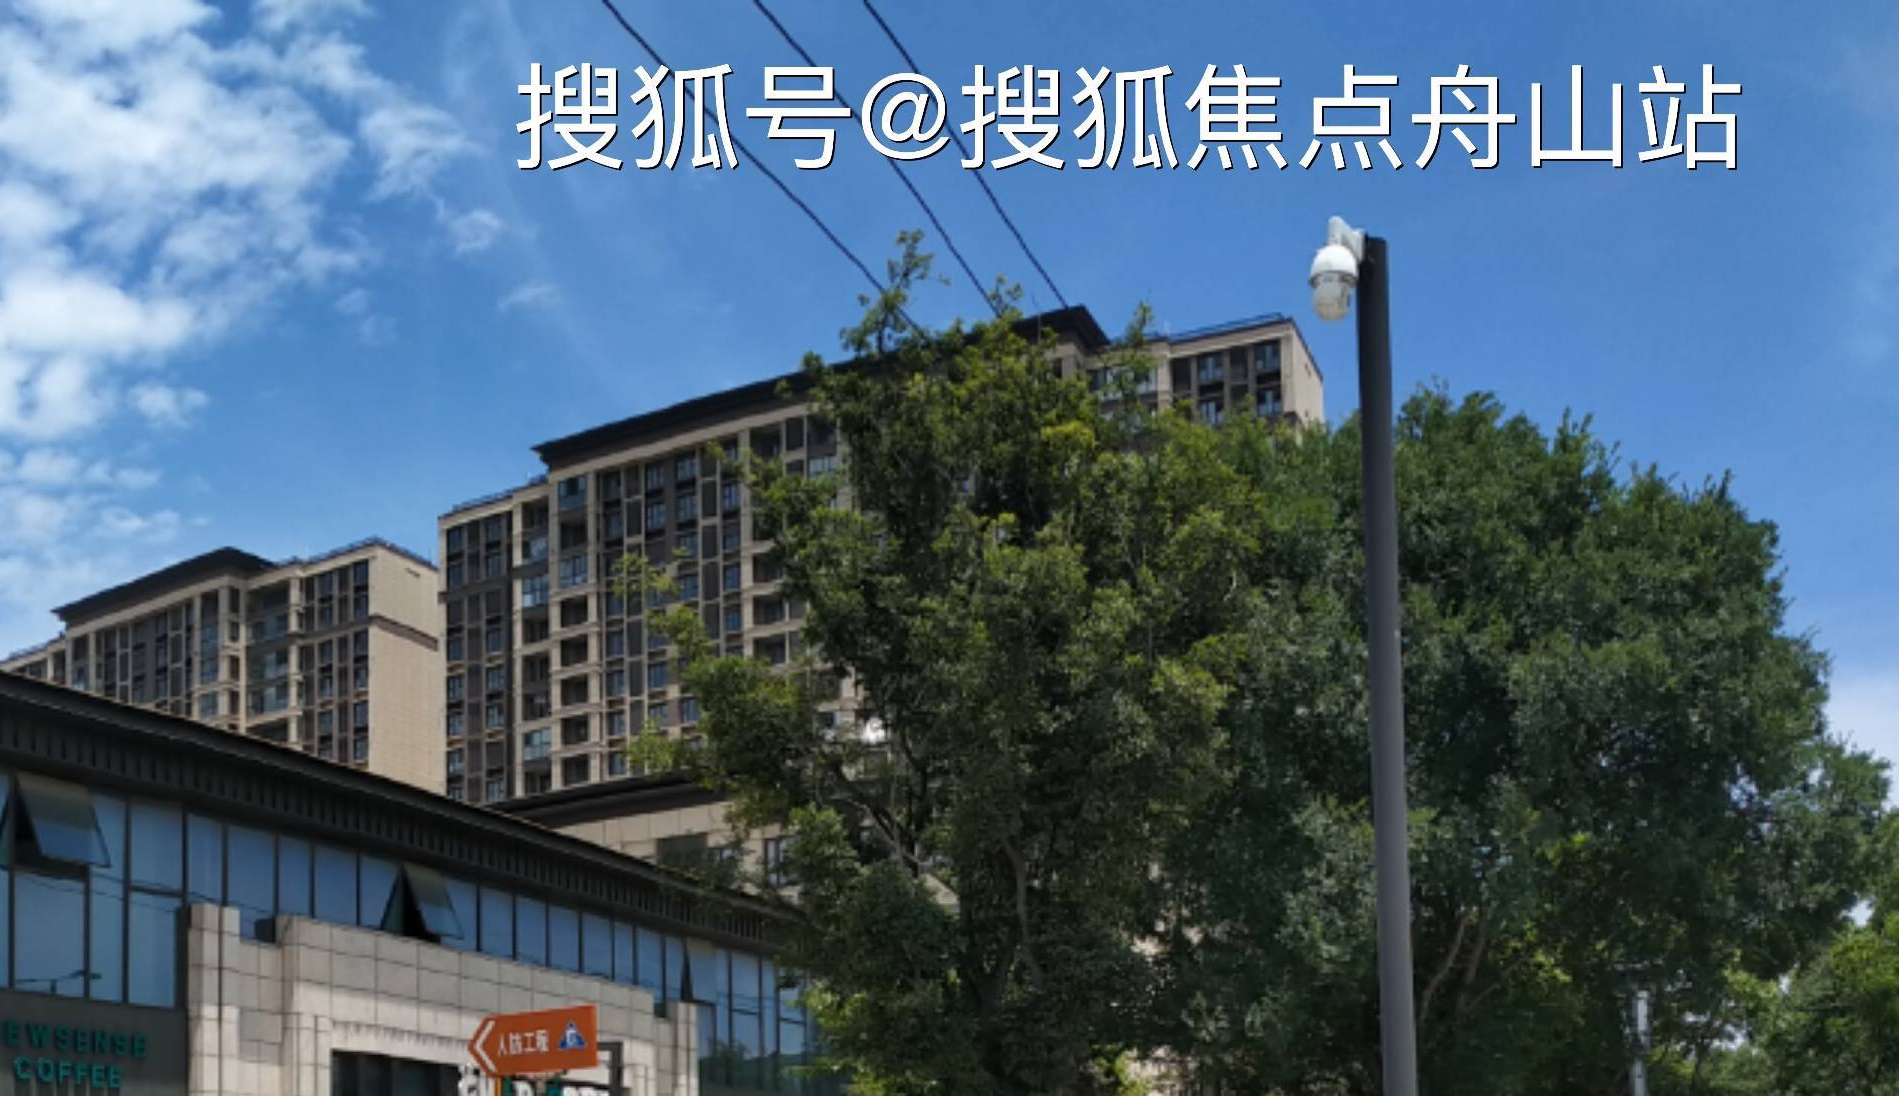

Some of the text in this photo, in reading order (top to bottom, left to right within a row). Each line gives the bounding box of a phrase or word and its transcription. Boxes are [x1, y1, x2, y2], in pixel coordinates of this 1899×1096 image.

[497, 1030, 550, 1057] 人防工程
[14, 1056, 121, 1088] COFFEE
